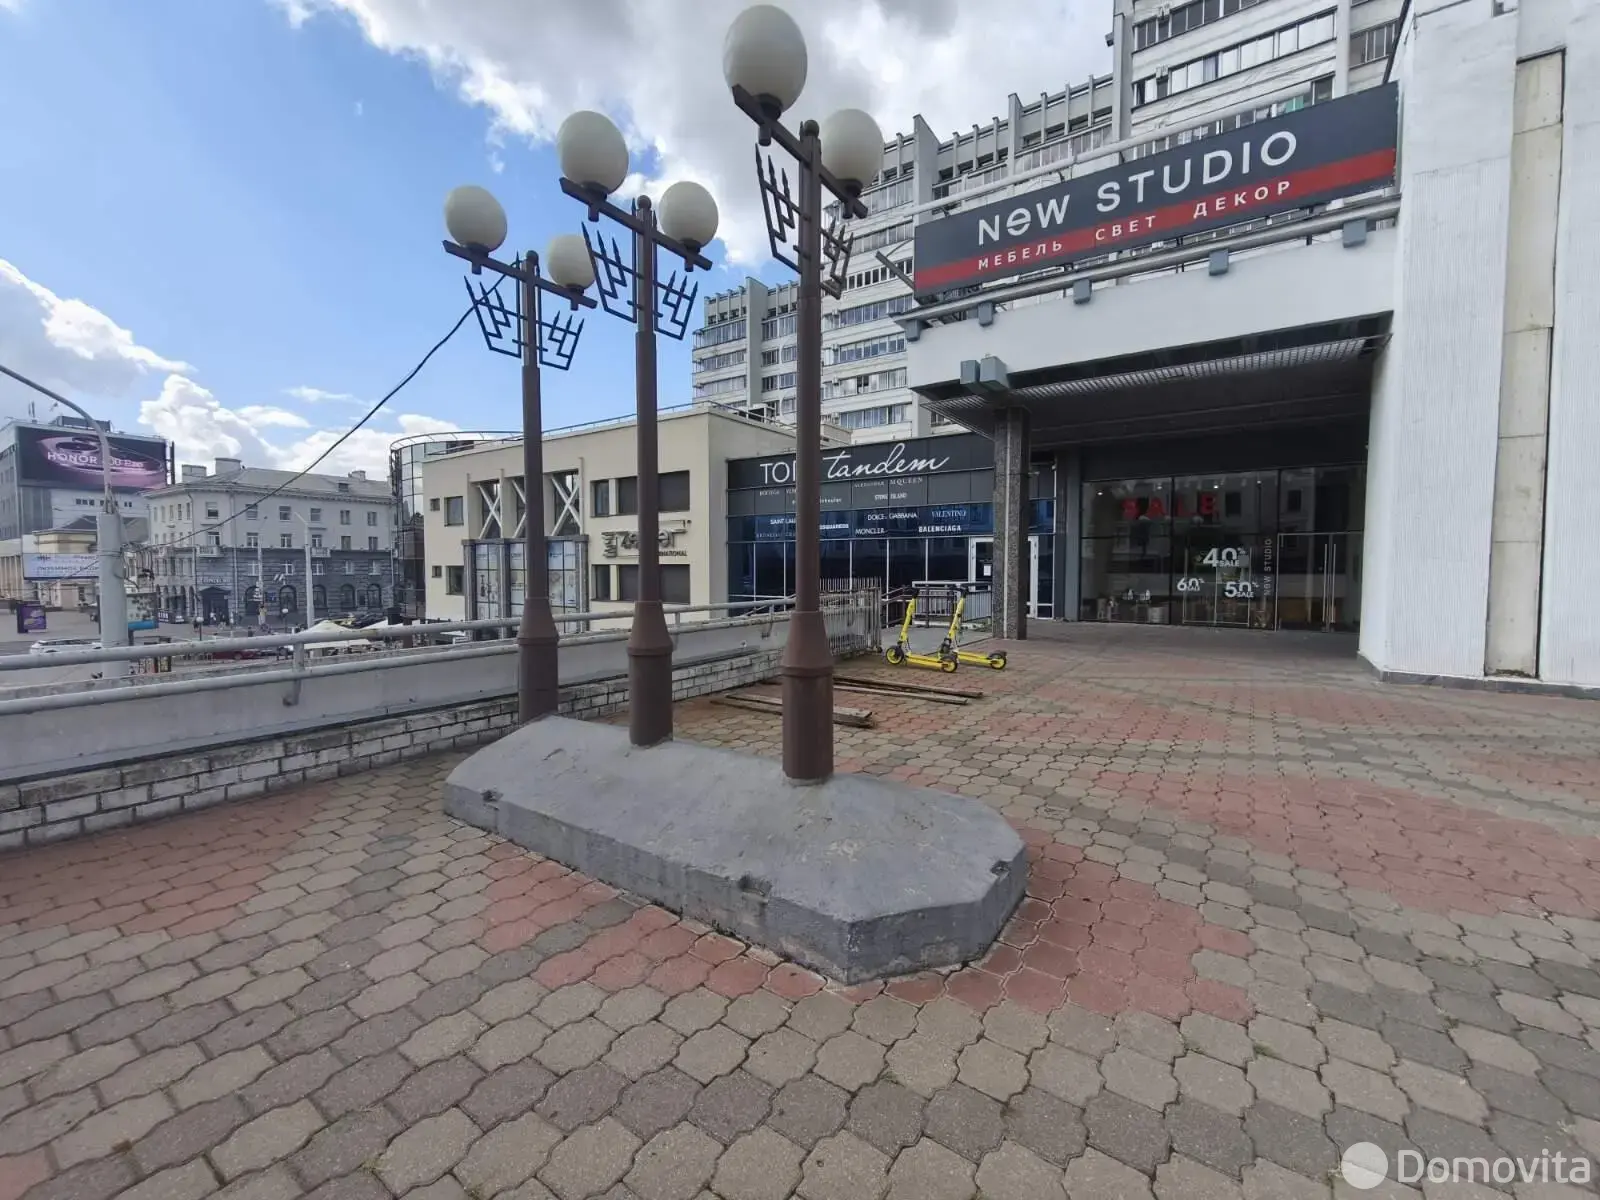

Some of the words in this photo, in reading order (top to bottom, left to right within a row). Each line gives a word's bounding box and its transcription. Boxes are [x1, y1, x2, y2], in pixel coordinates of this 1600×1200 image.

[1095, 130, 1298, 214] STUDIO
[977, 239, 1064, 271] МЕБЕЛЬ
[1095, 214, 1157, 242] СВЕТ
[1192, 179, 1292, 219] ДЕКОР
[47, 451, 98, 465] HONOR
[760, 460, 797, 485] TO
[822, 442, 950, 479] tandem
[889, 511, 918, 521] GABBANA
[931, 509, 967, 518] VALENTINO
[855, 527, 885, 536] MONCLER
[918, 524, 962, 533] BALENCIAGA
[1263, 538, 1273, 572] STUDIO
